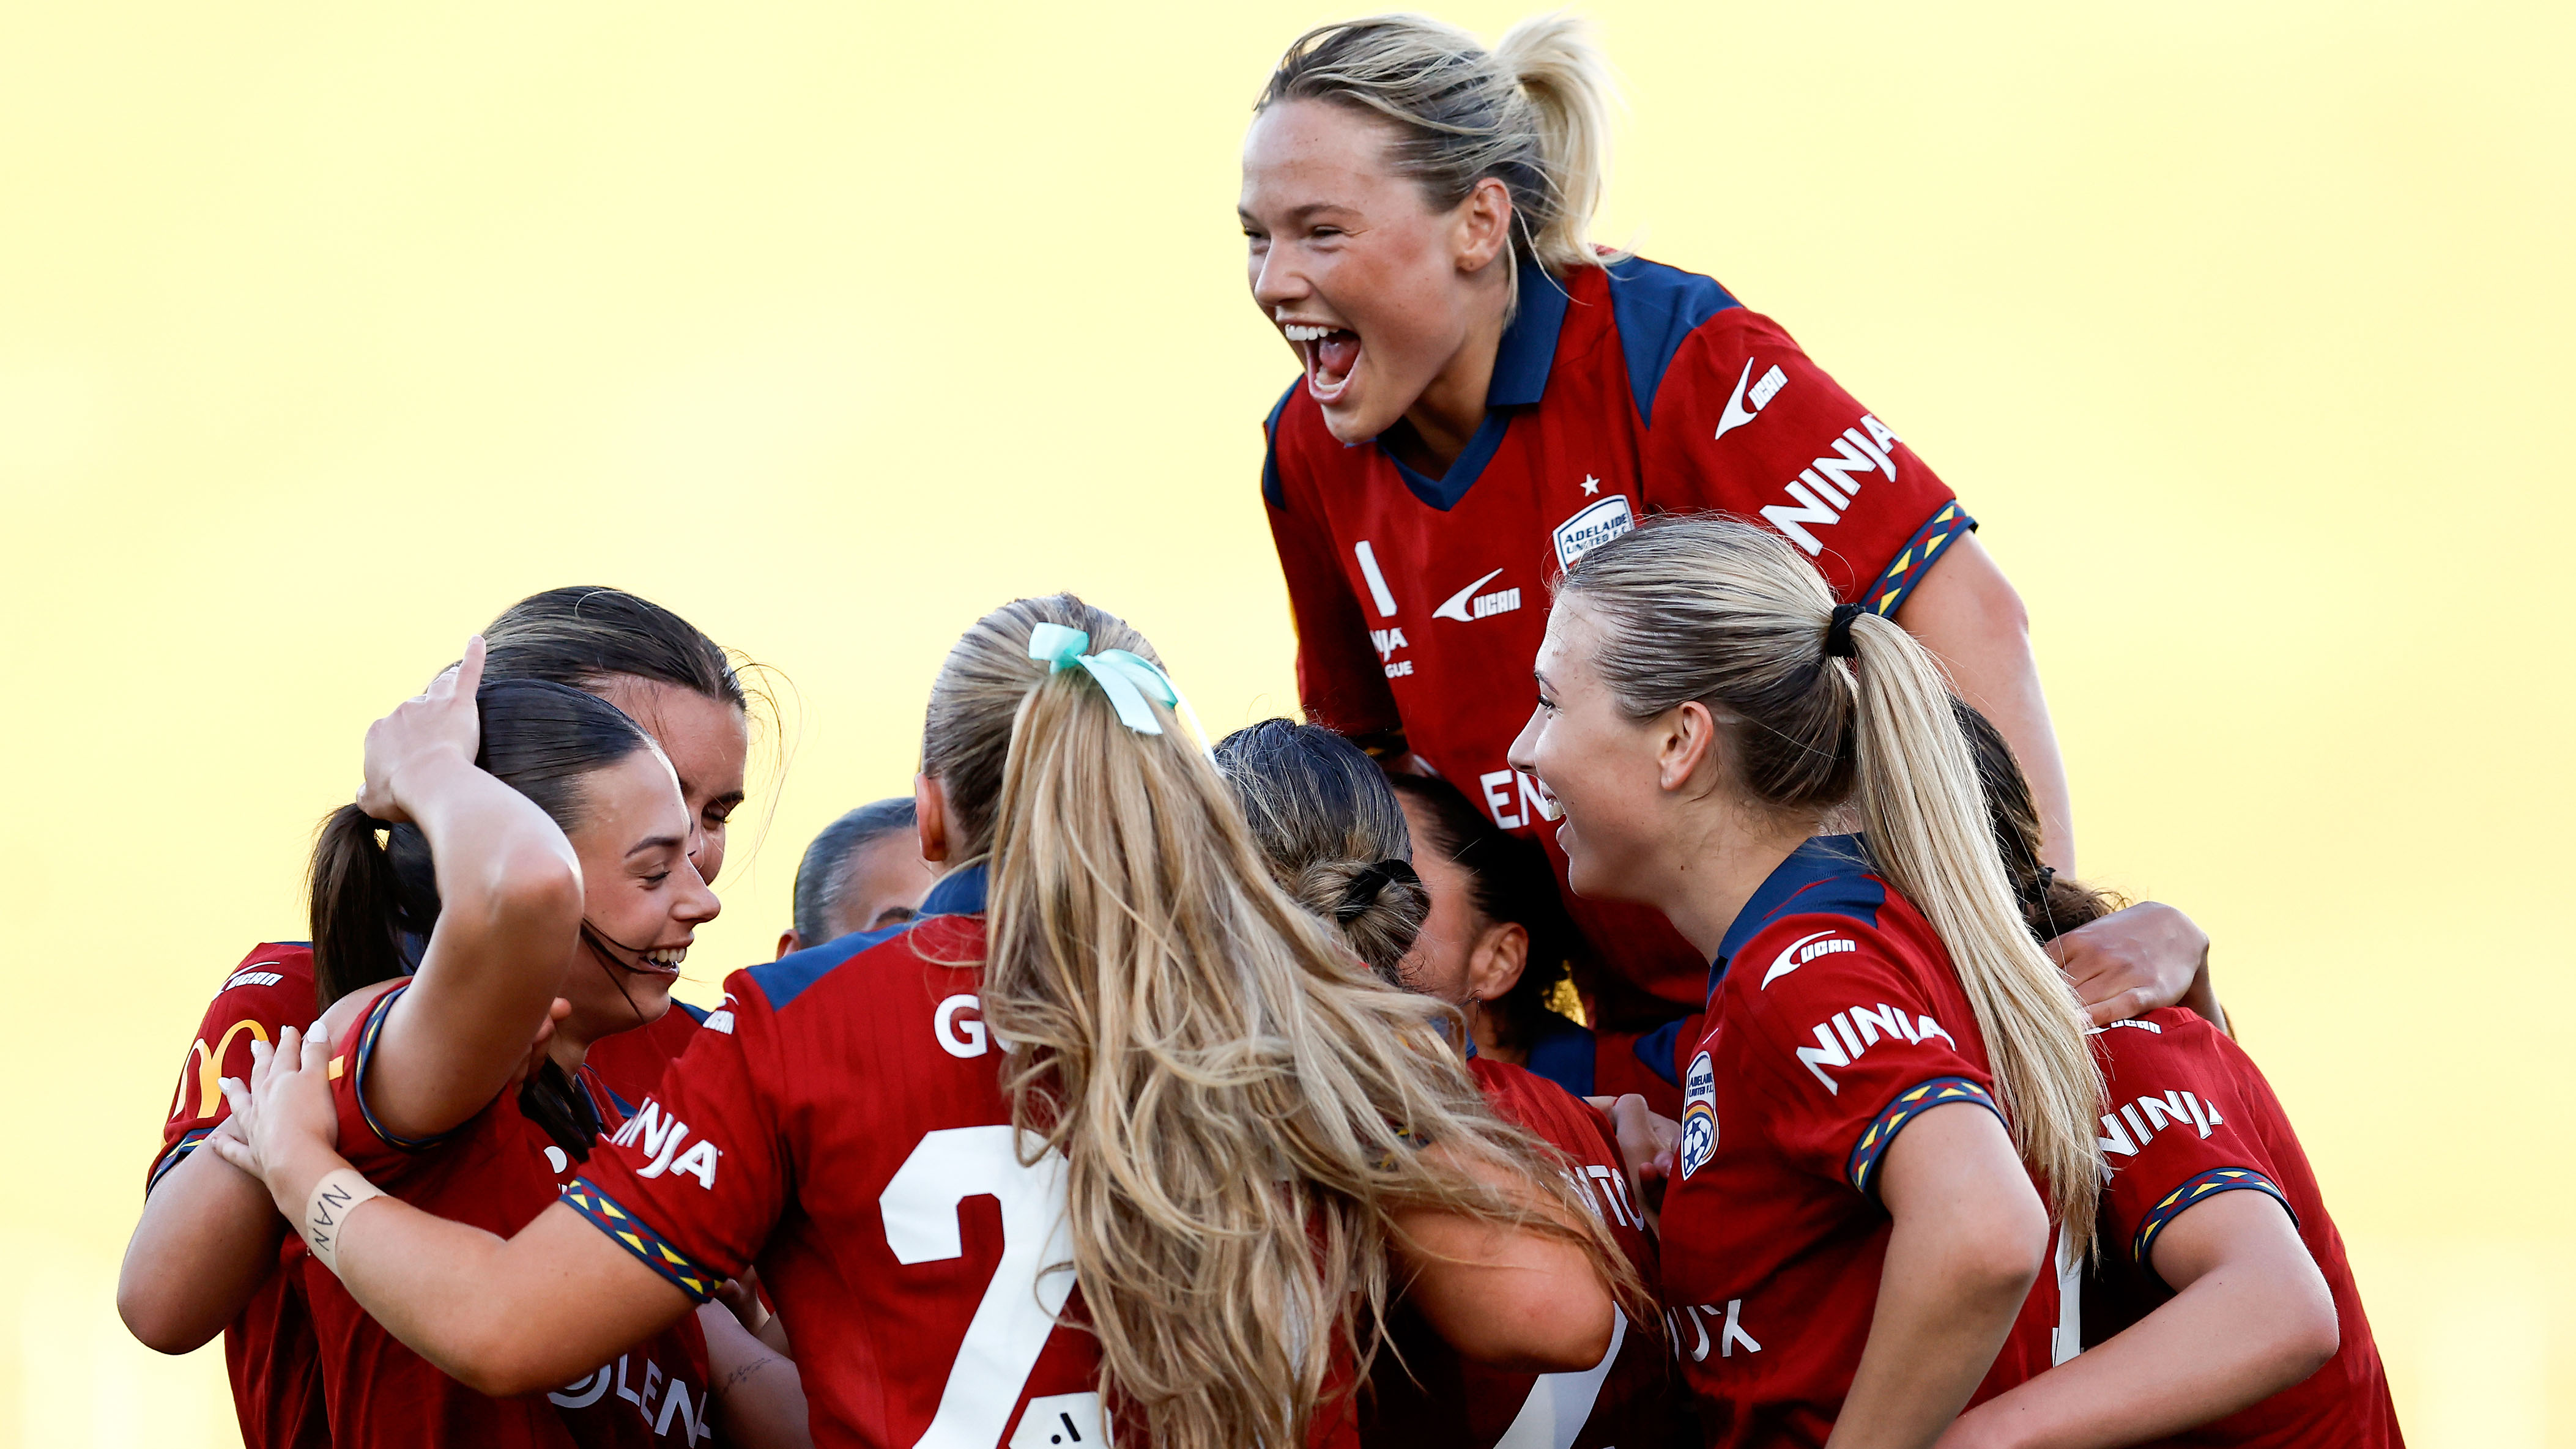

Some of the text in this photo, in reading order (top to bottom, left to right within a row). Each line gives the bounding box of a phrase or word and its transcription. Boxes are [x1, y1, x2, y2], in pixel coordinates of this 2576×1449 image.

[1759, 413, 1903, 557] NINJA
[1564, 513, 1628, 546] ADELAIDE
[1566, 532, 1609, 554] UNTED
[1370, 627, 1409, 662] NJA
[1384, 660, 1414, 678] GUE
[1795, 1002, 1956, 1097] NINJA
[313, 1184, 352, 1252] NAN
